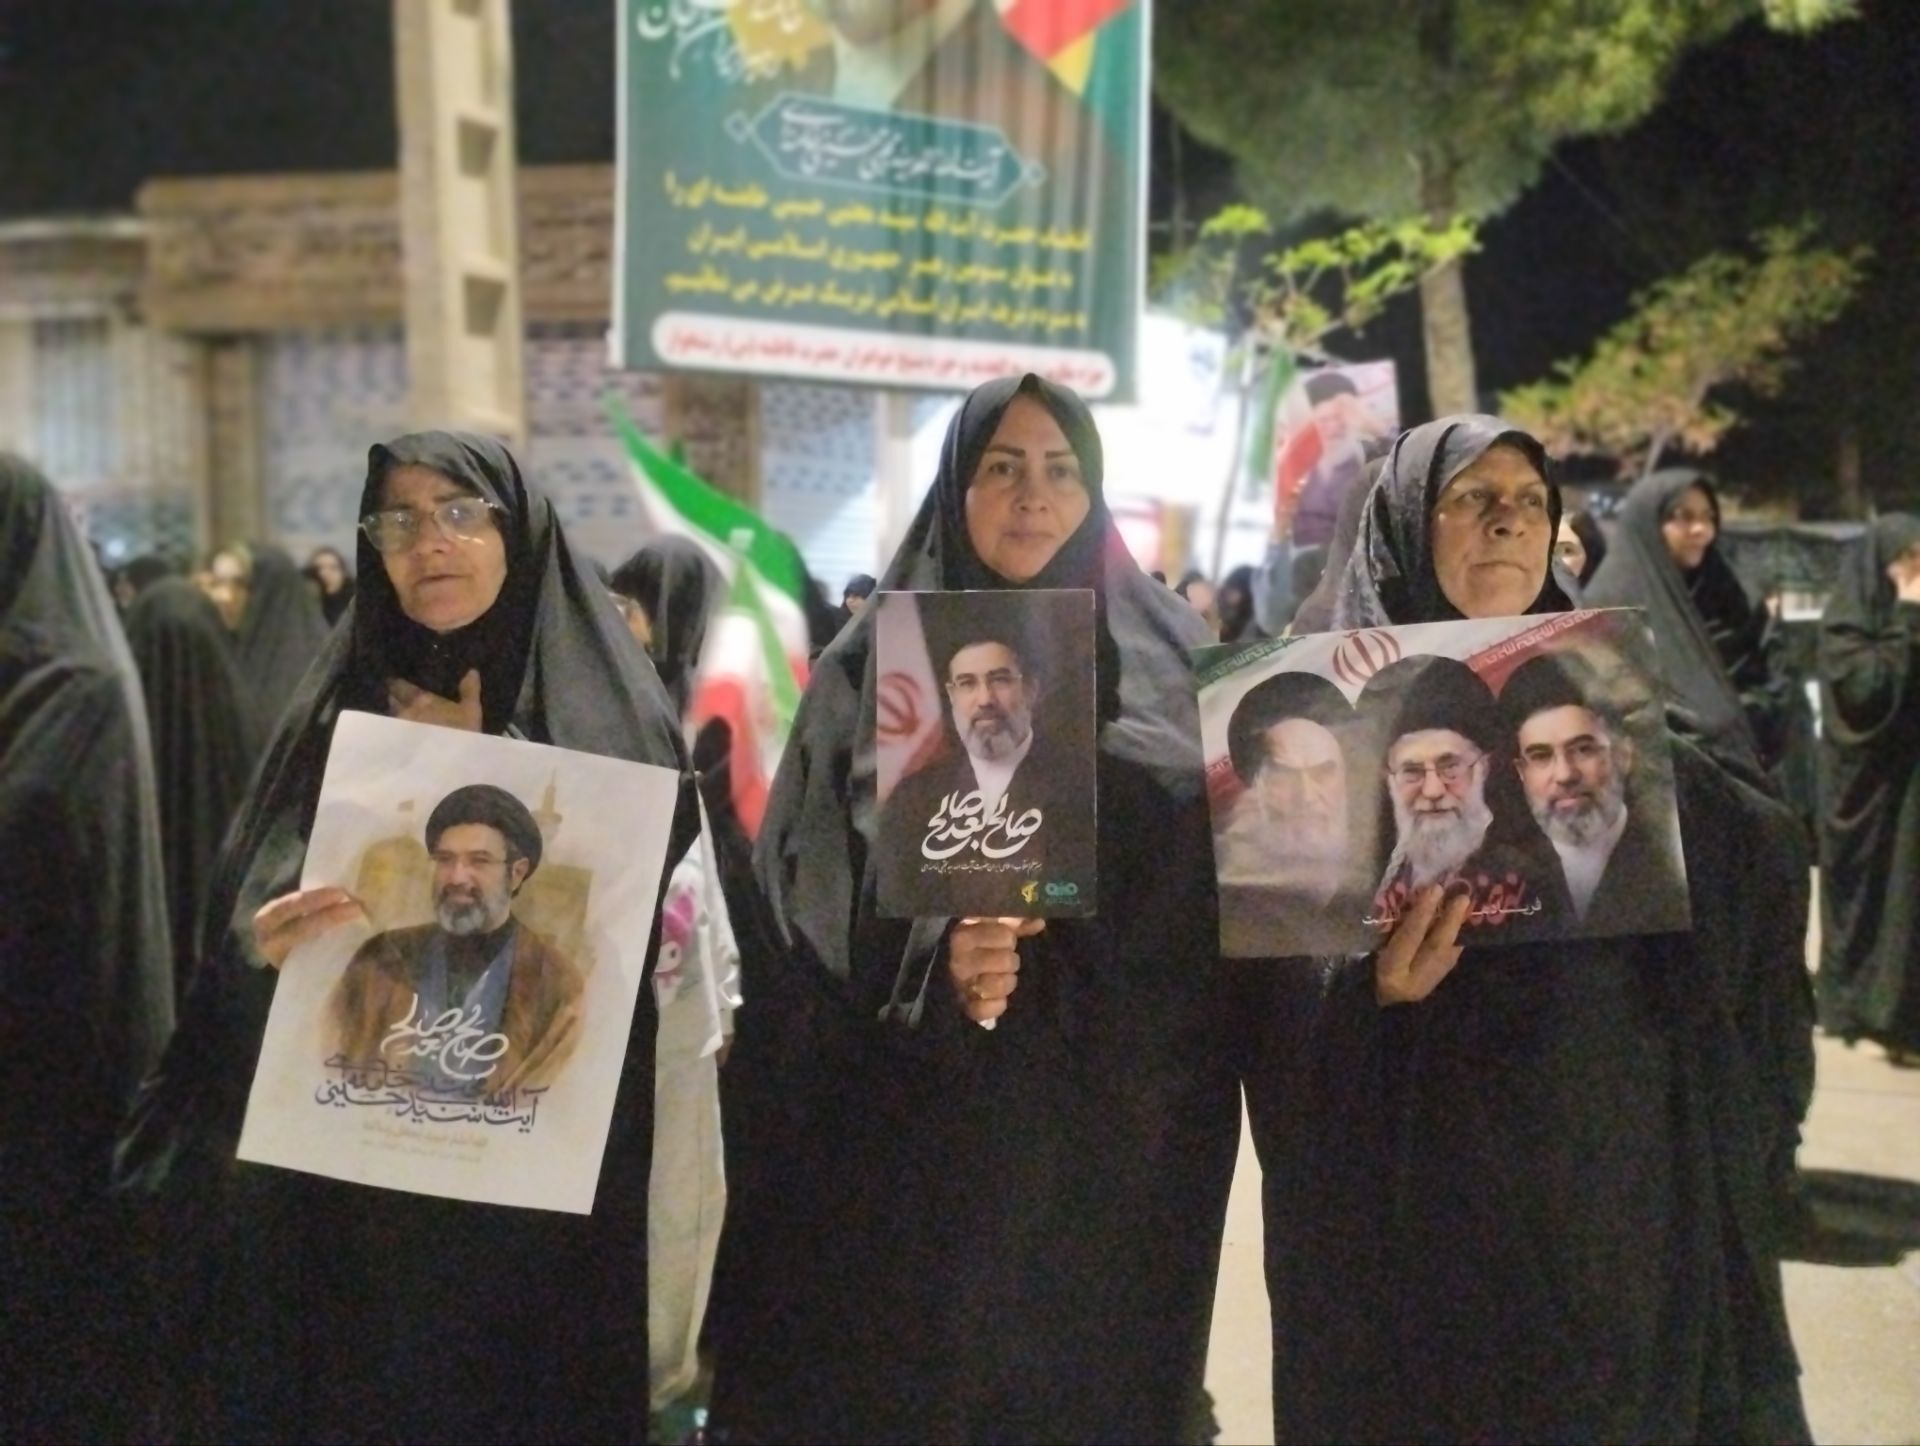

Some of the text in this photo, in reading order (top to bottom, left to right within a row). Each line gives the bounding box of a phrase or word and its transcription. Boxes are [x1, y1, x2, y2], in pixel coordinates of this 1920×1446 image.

[921, 789, 985, 860] صالح
[981, 792, 1043, 859] صالح
[380, 993, 463, 1055] صالح
[440, 1004, 510, 1080] صالح
[314, 1080, 409, 1109] حسینی
